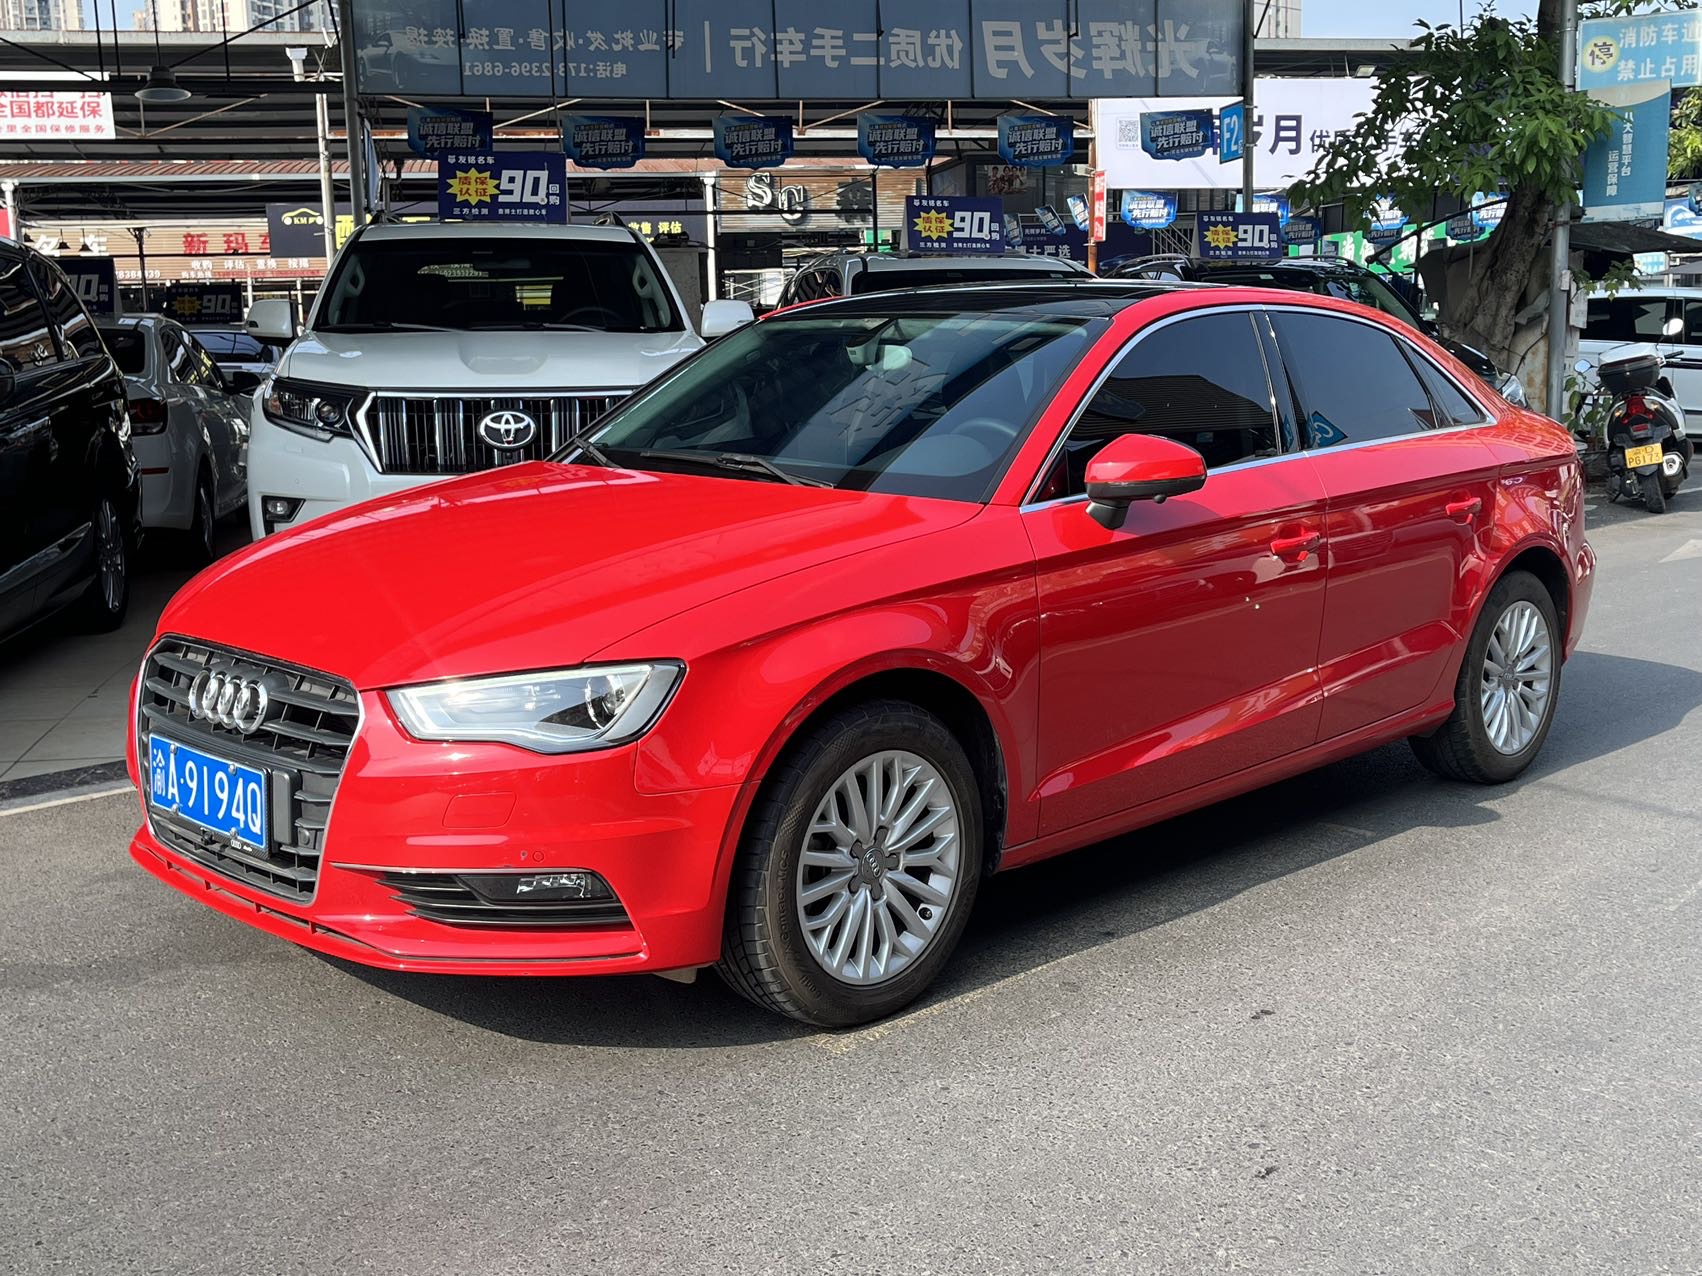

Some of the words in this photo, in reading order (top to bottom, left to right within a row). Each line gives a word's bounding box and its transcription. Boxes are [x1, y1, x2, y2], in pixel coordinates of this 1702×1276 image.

[1617, 54, 1699, 81] 禁止占用
[0, 124, 105, 134] 里全国保修服务
[458, 187, 489, 197] 认证
[498, 169, 549, 203] 90
[952, 211, 990, 240] 90
[1237, 224, 1270, 248] 90
